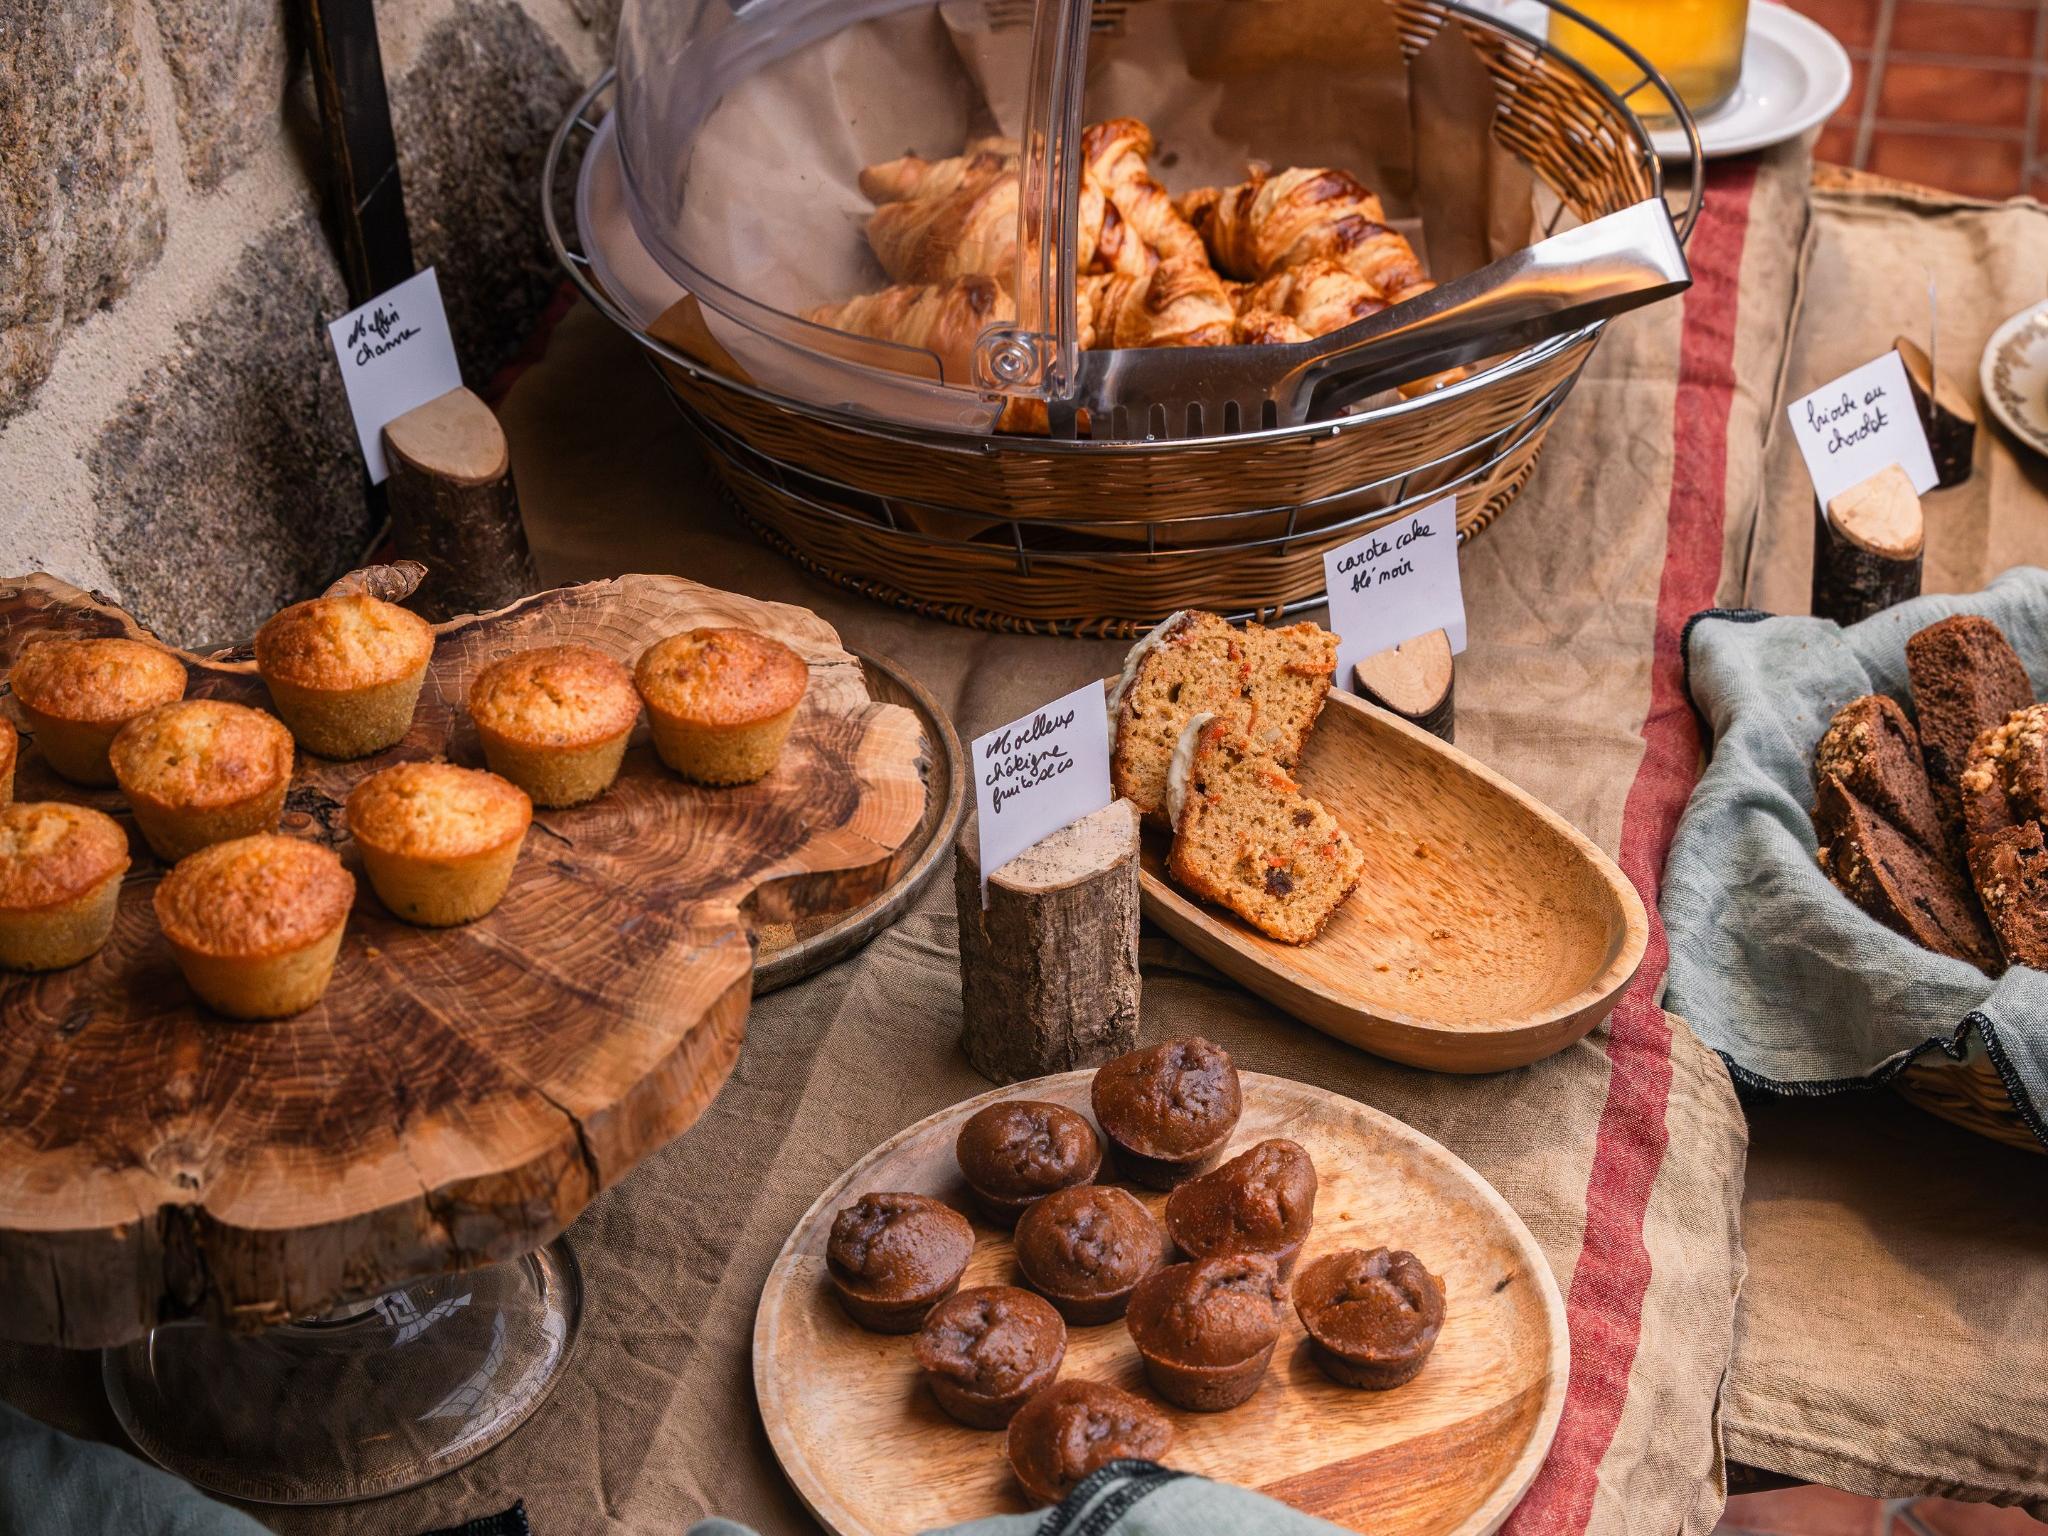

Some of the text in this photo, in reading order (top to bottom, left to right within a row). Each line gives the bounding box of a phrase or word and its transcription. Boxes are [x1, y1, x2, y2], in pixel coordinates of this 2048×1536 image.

[1864, 386, 1886, 405] au
[1396, 519, 1436, 550] cake
[1351, 557, 1414, 593] blé noir
[986, 709, 1075, 759] Moelleux
[992, 775, 1034, 814] fruits
